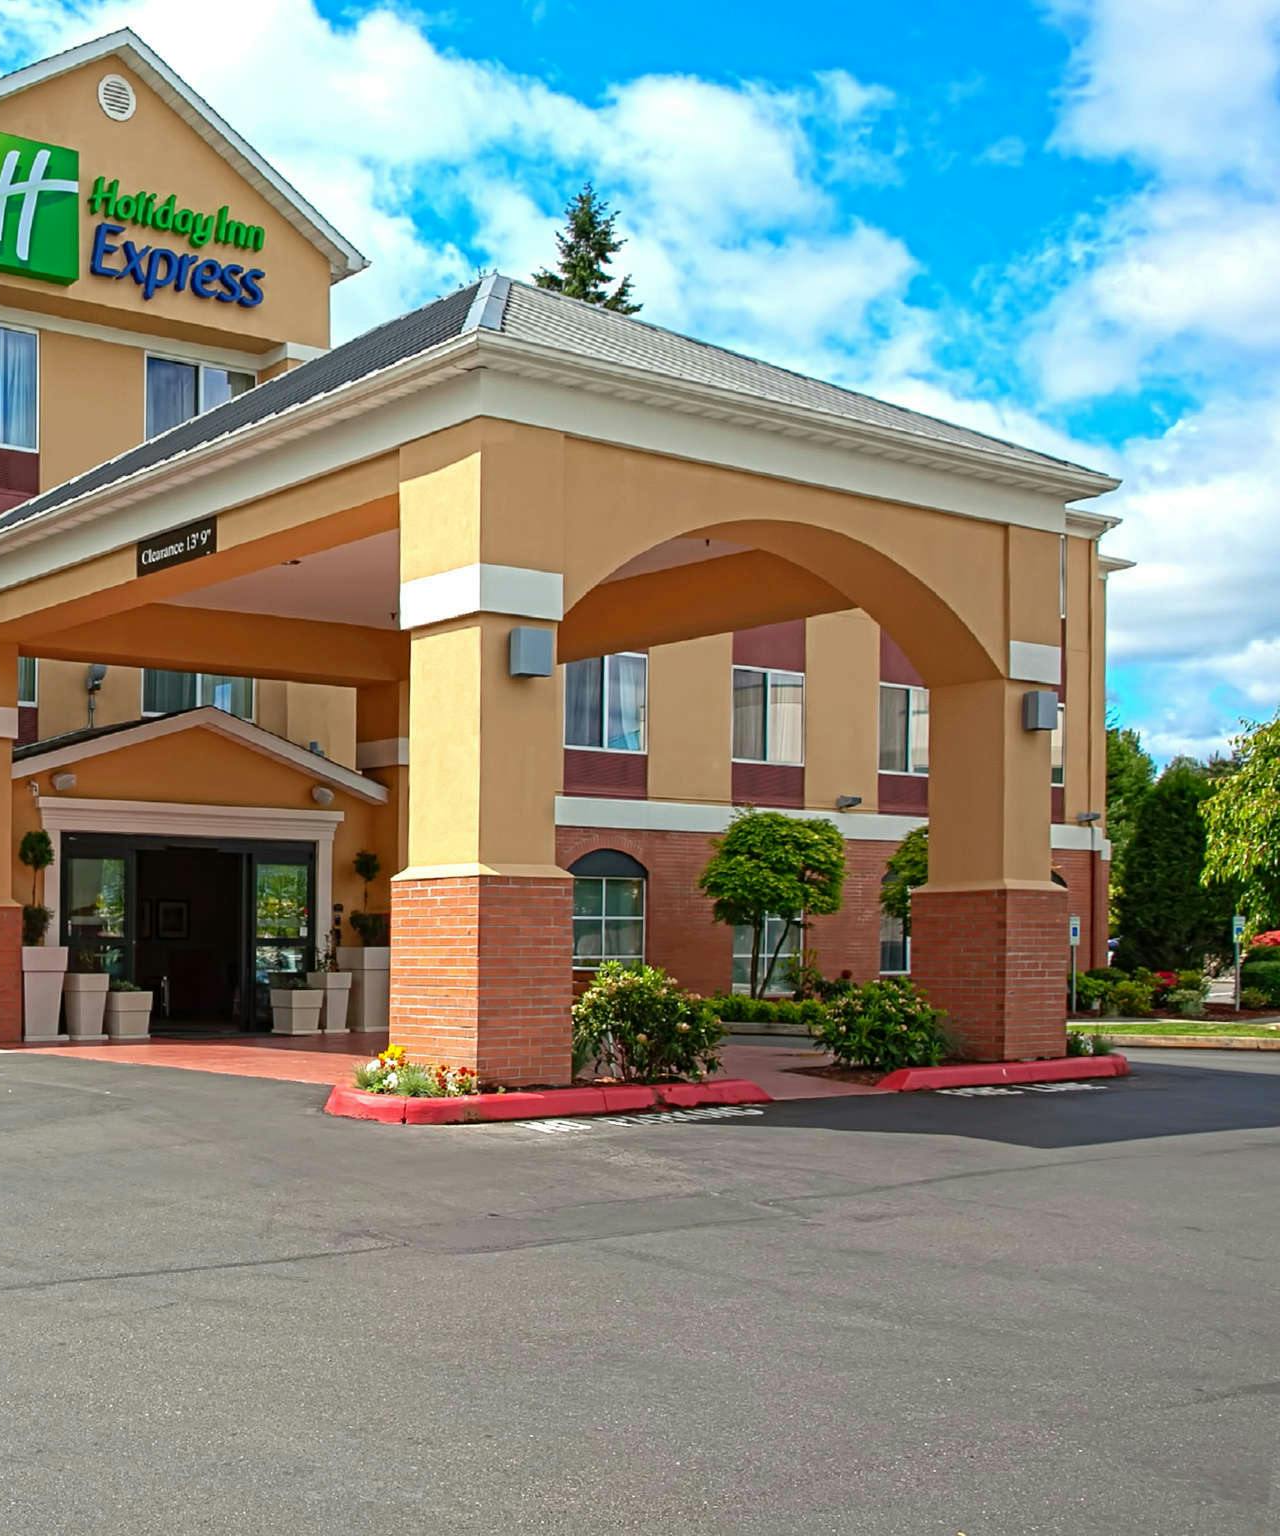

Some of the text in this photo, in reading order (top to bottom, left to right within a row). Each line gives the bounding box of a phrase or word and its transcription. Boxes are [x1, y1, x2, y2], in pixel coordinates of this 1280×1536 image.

[87, 176, 265, 251] Holiday Inn
[89, 222, 266, 308] Express
[141, 542, 184, 565] Clearance
[514, 1103, 769, 1134] NO PARKING
